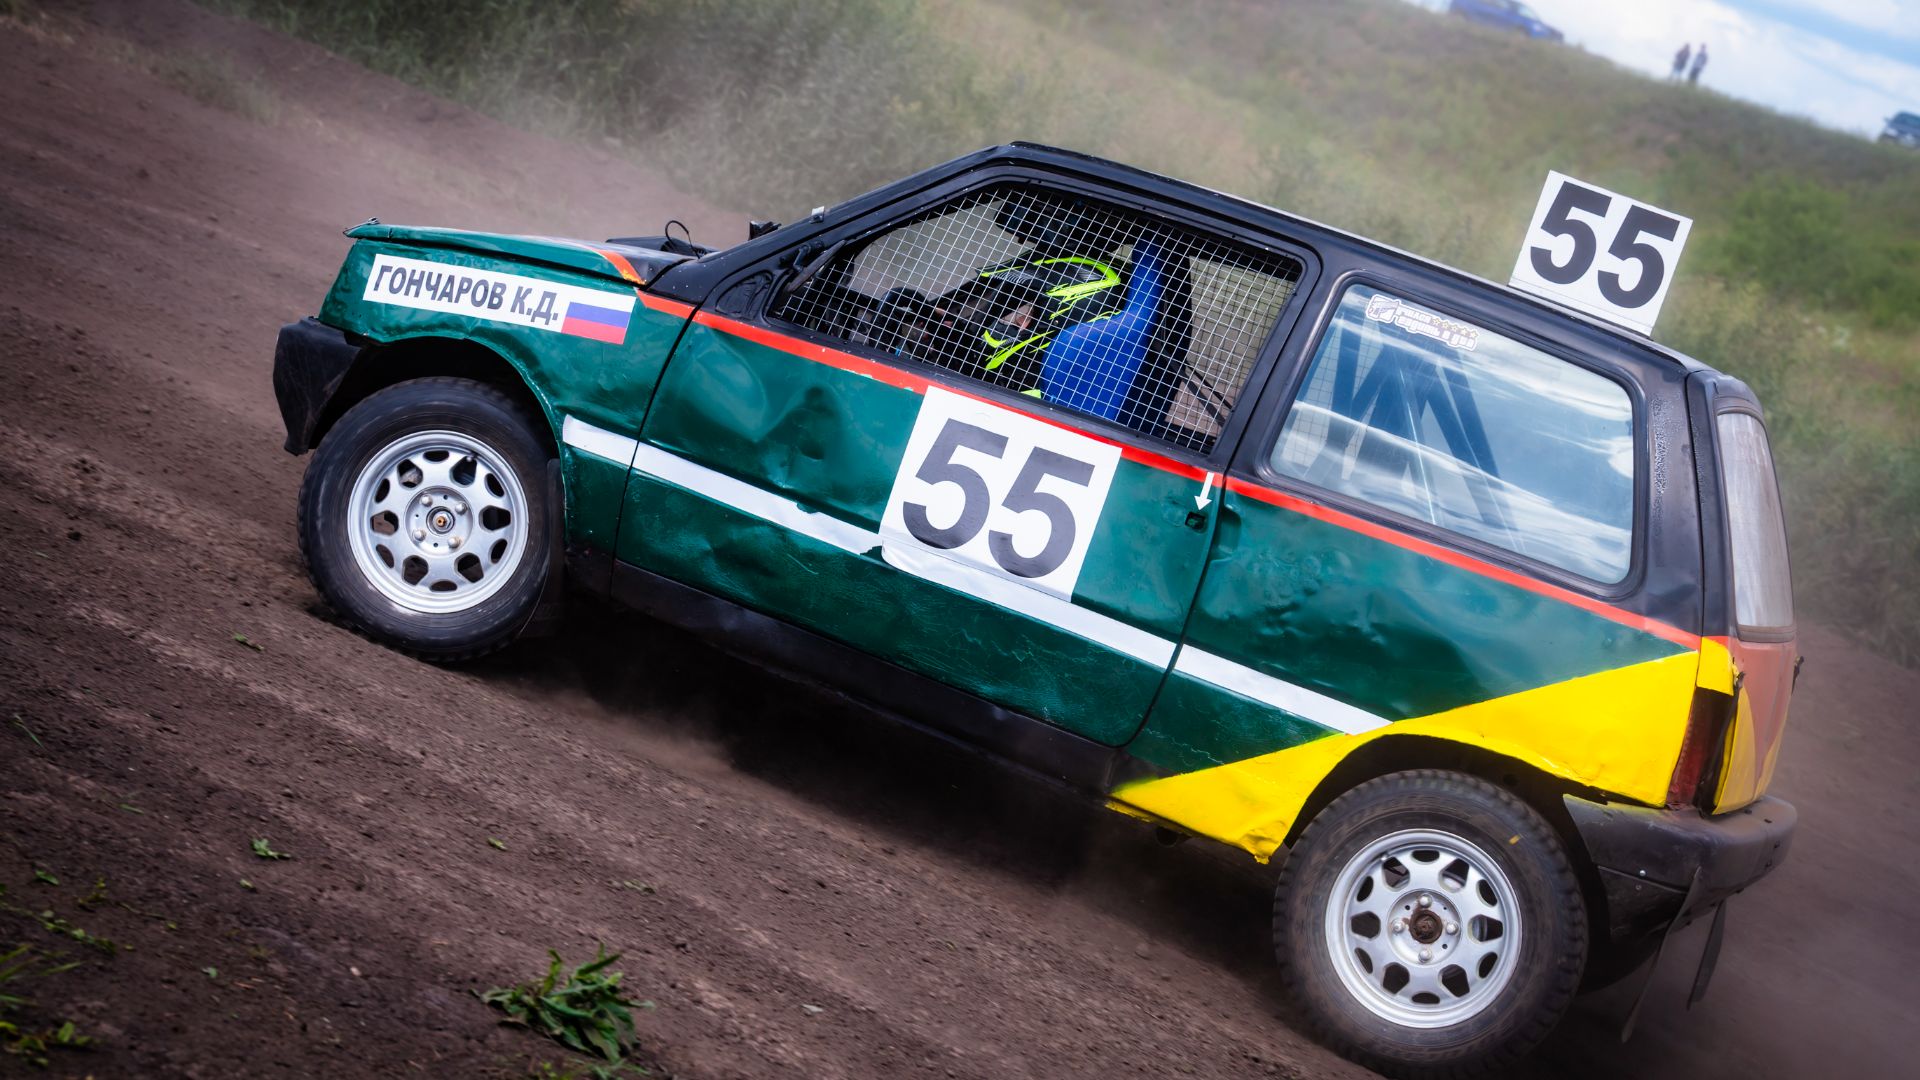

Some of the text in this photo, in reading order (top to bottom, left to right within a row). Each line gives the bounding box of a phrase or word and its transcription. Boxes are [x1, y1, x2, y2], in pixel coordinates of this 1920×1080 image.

[373, 264, 559, 326] ГОНЧАРОВ К.Д.
[1530, 180, 1681, 309] 55
[902, 417, 1096, 579] 55
